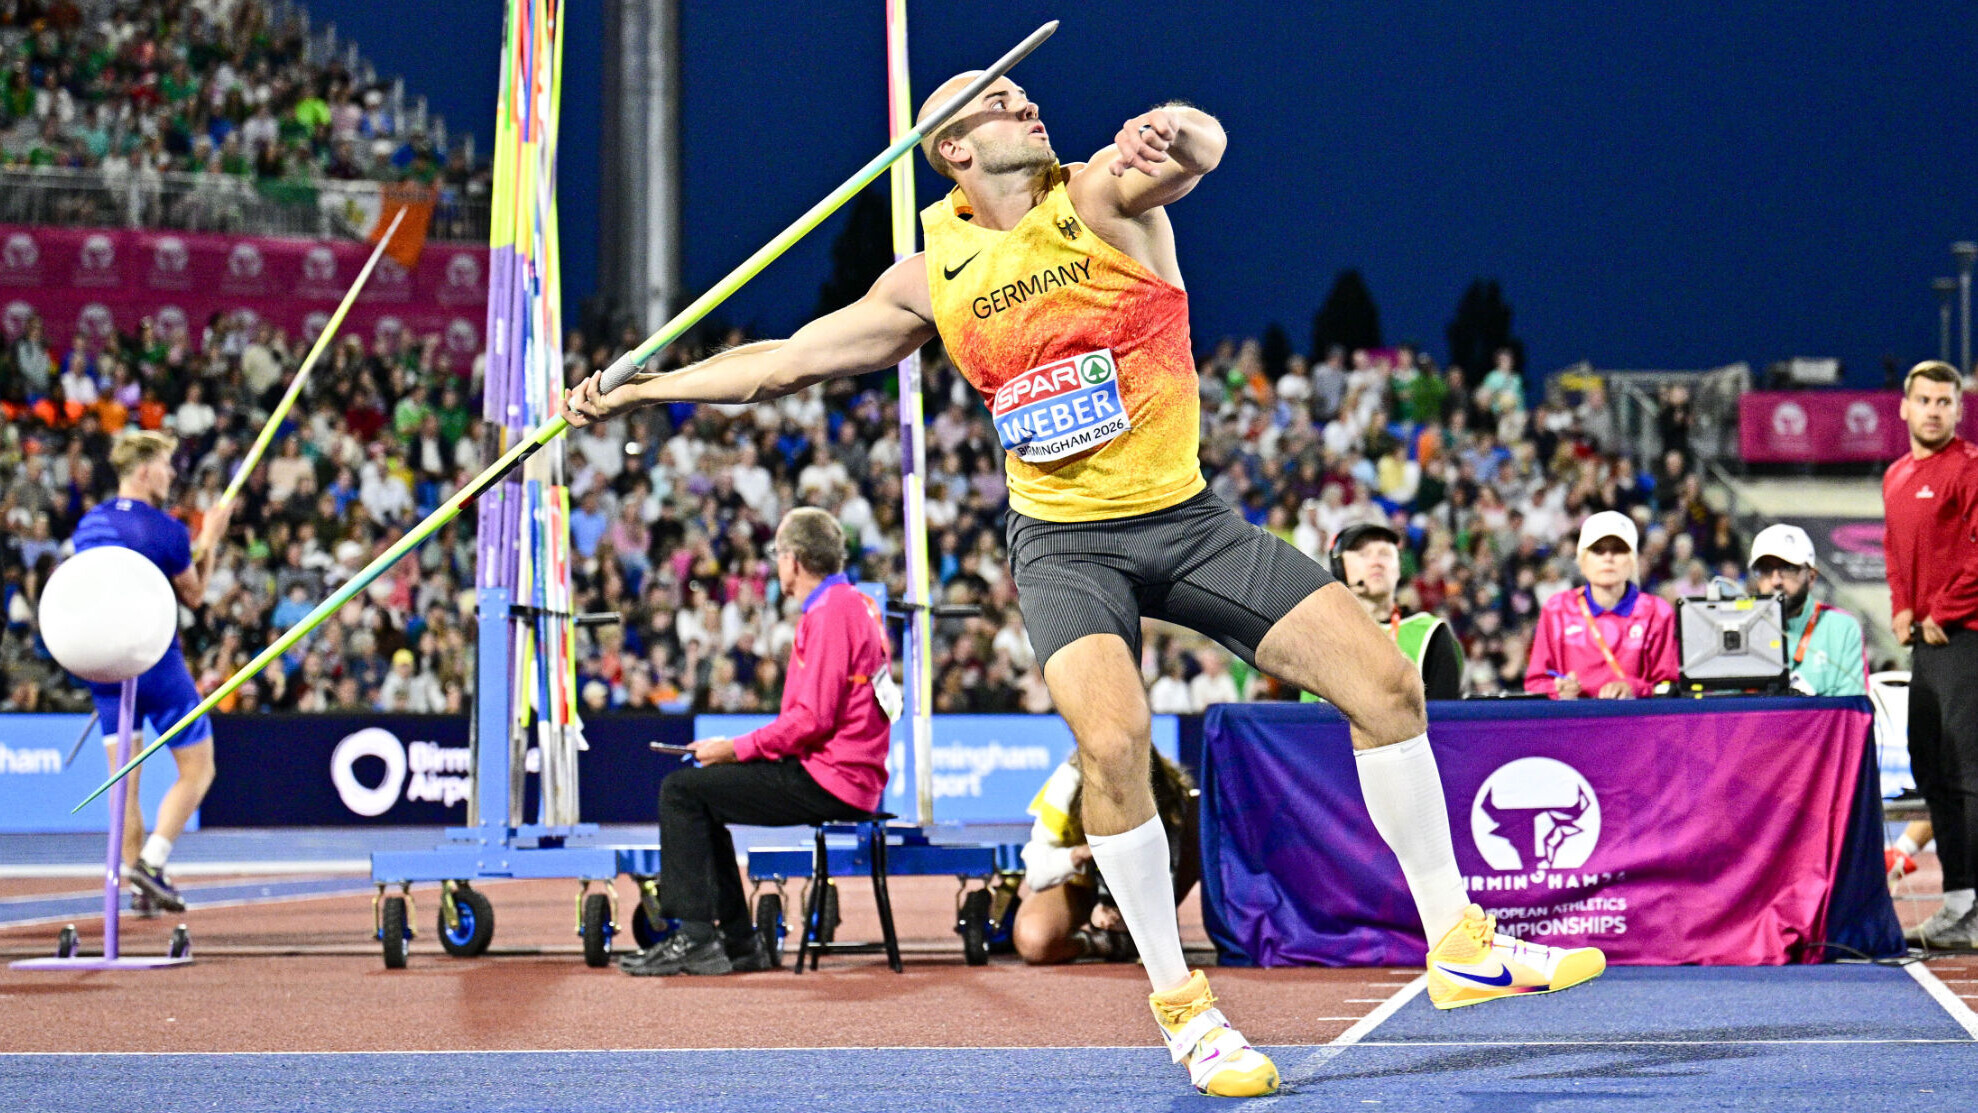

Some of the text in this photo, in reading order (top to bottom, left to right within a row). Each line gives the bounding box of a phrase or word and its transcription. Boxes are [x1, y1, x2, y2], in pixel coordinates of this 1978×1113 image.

[973, 258, 1090, 319] GERMANY
[997, 366, 1078, 411] SPAR
[1002, 389, 1116, 445] WEBER
[1093, 418, 1124, 439] 2026
[1463, 870, 1598, 891] IRMINGHAM
[1553, 898, 1627, 914] ATHLETICS
[1497, 916, 1627, 938] MPIONSHIPS
